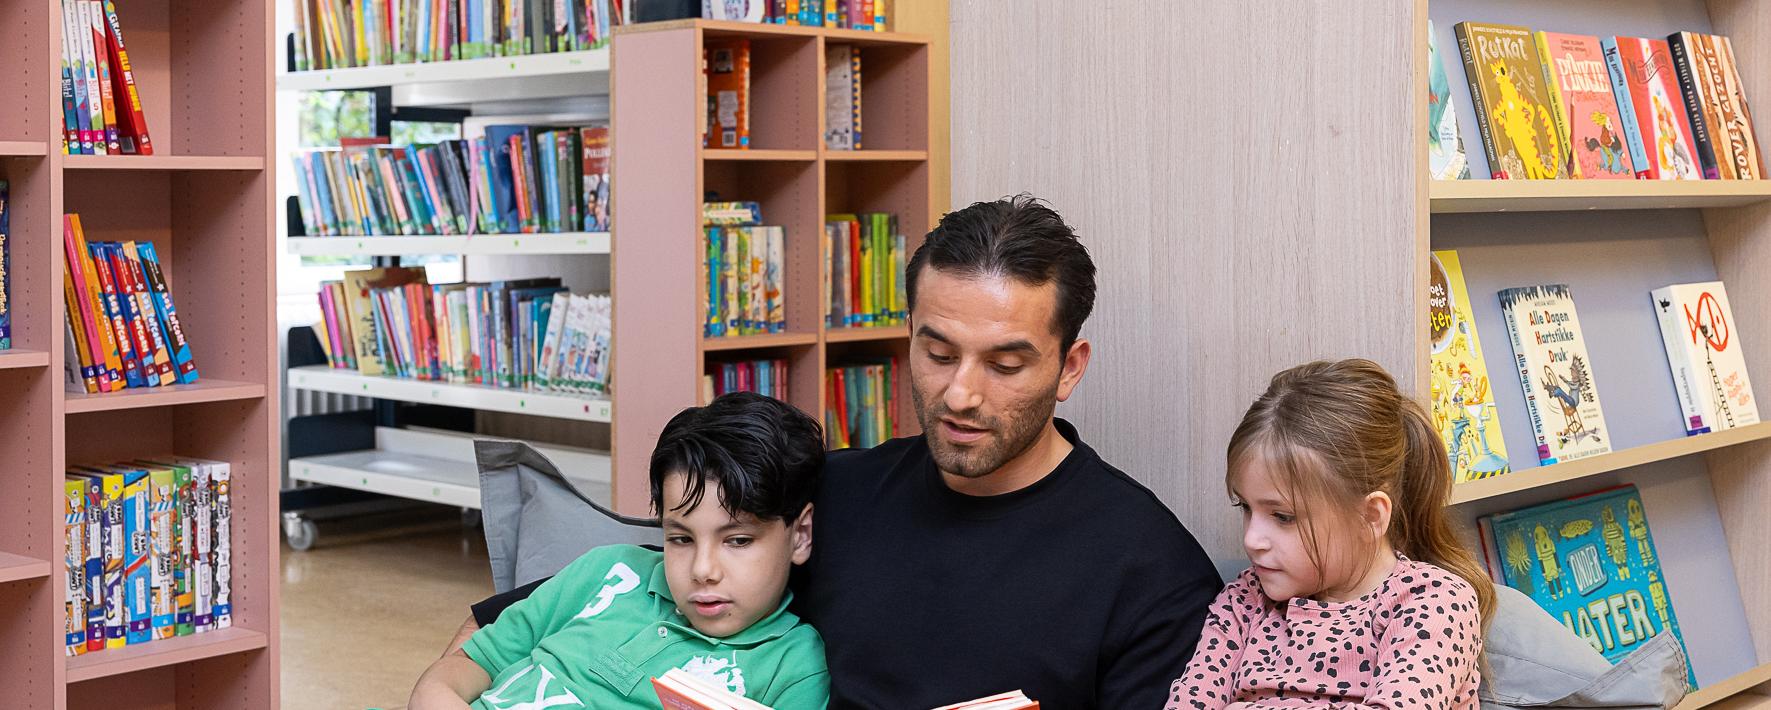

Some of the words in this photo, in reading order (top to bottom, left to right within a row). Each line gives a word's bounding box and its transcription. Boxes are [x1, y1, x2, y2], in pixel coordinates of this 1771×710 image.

[1727, 119, 1752, 180] ROVER
[1431, 283, 1444, 296] oet
[1431, 297, 1446, 308] over
[1430, 312, 1452, 332] ten
[1529, 310, 1544, 326] Alle
[1545, 310, 1569, 326] Dagen
[1535, 327, 1574, 345] Hartstikke
[1548, 348, 1568, 363] Druk
[1517, 353, 1525, 369] Alle
[1521, 369, 1532, 393] Dagen
[1528, 395, 1542, 434] Hartstikke
